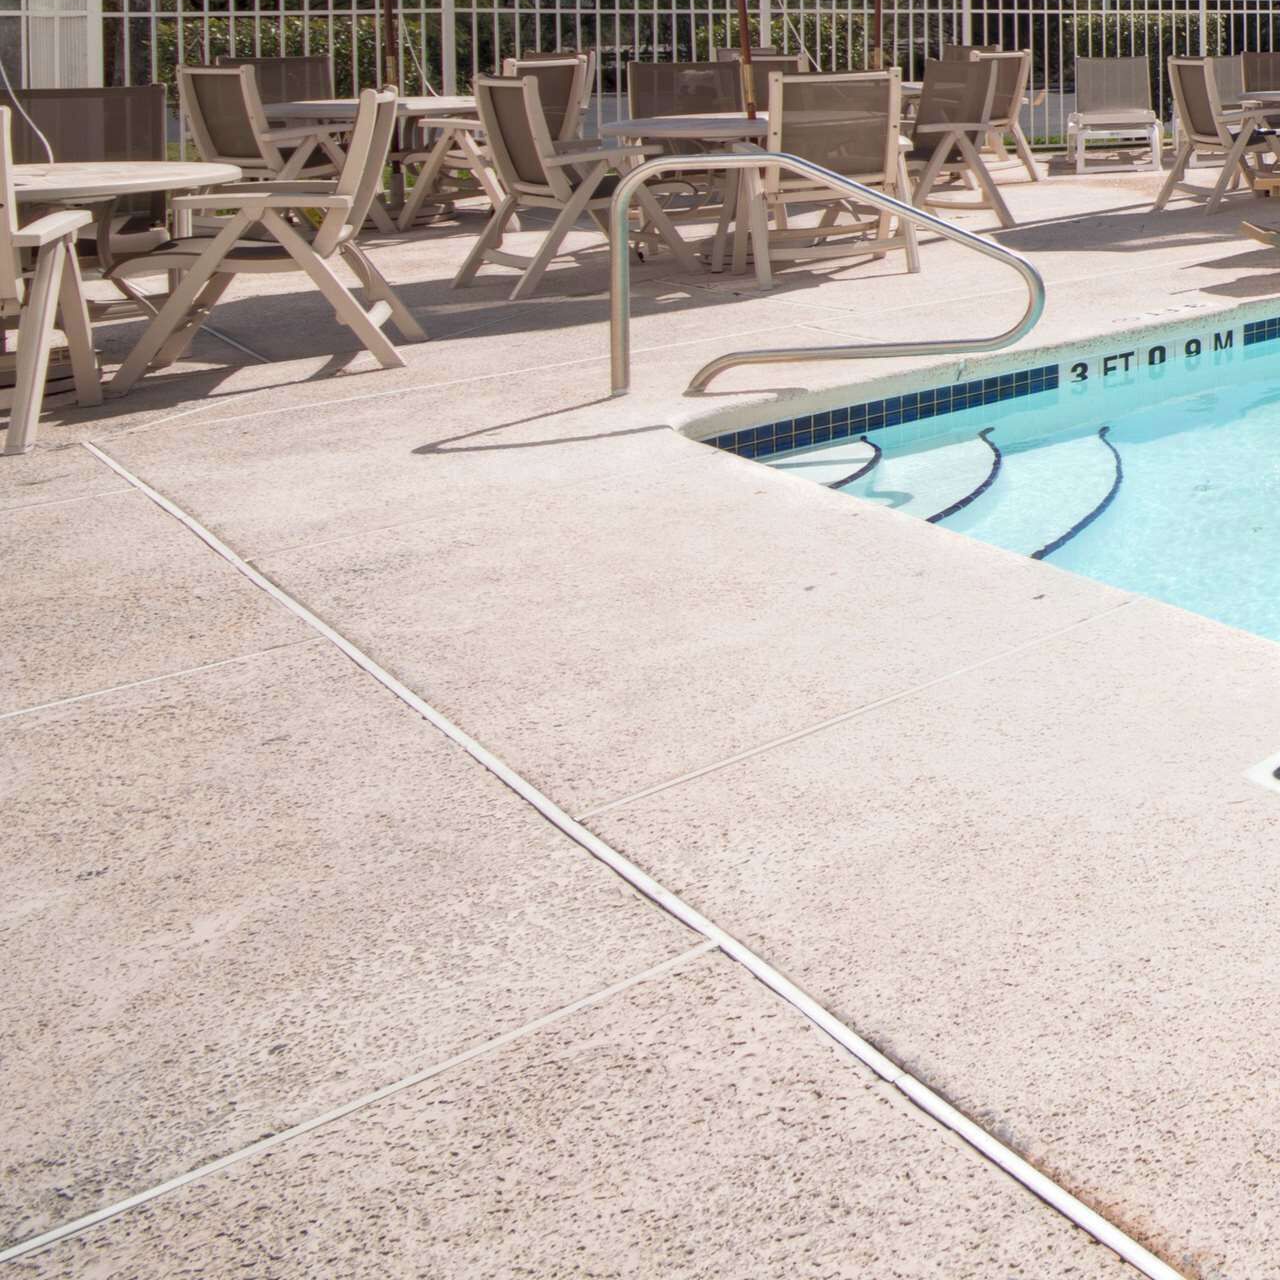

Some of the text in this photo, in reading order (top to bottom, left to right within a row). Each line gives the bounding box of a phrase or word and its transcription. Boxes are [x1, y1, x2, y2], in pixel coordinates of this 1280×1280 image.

[1070, 362, 1089, 383] 3
[1103, 351, 1135, 377] FT
[1213, 329, 1233, 352] M
